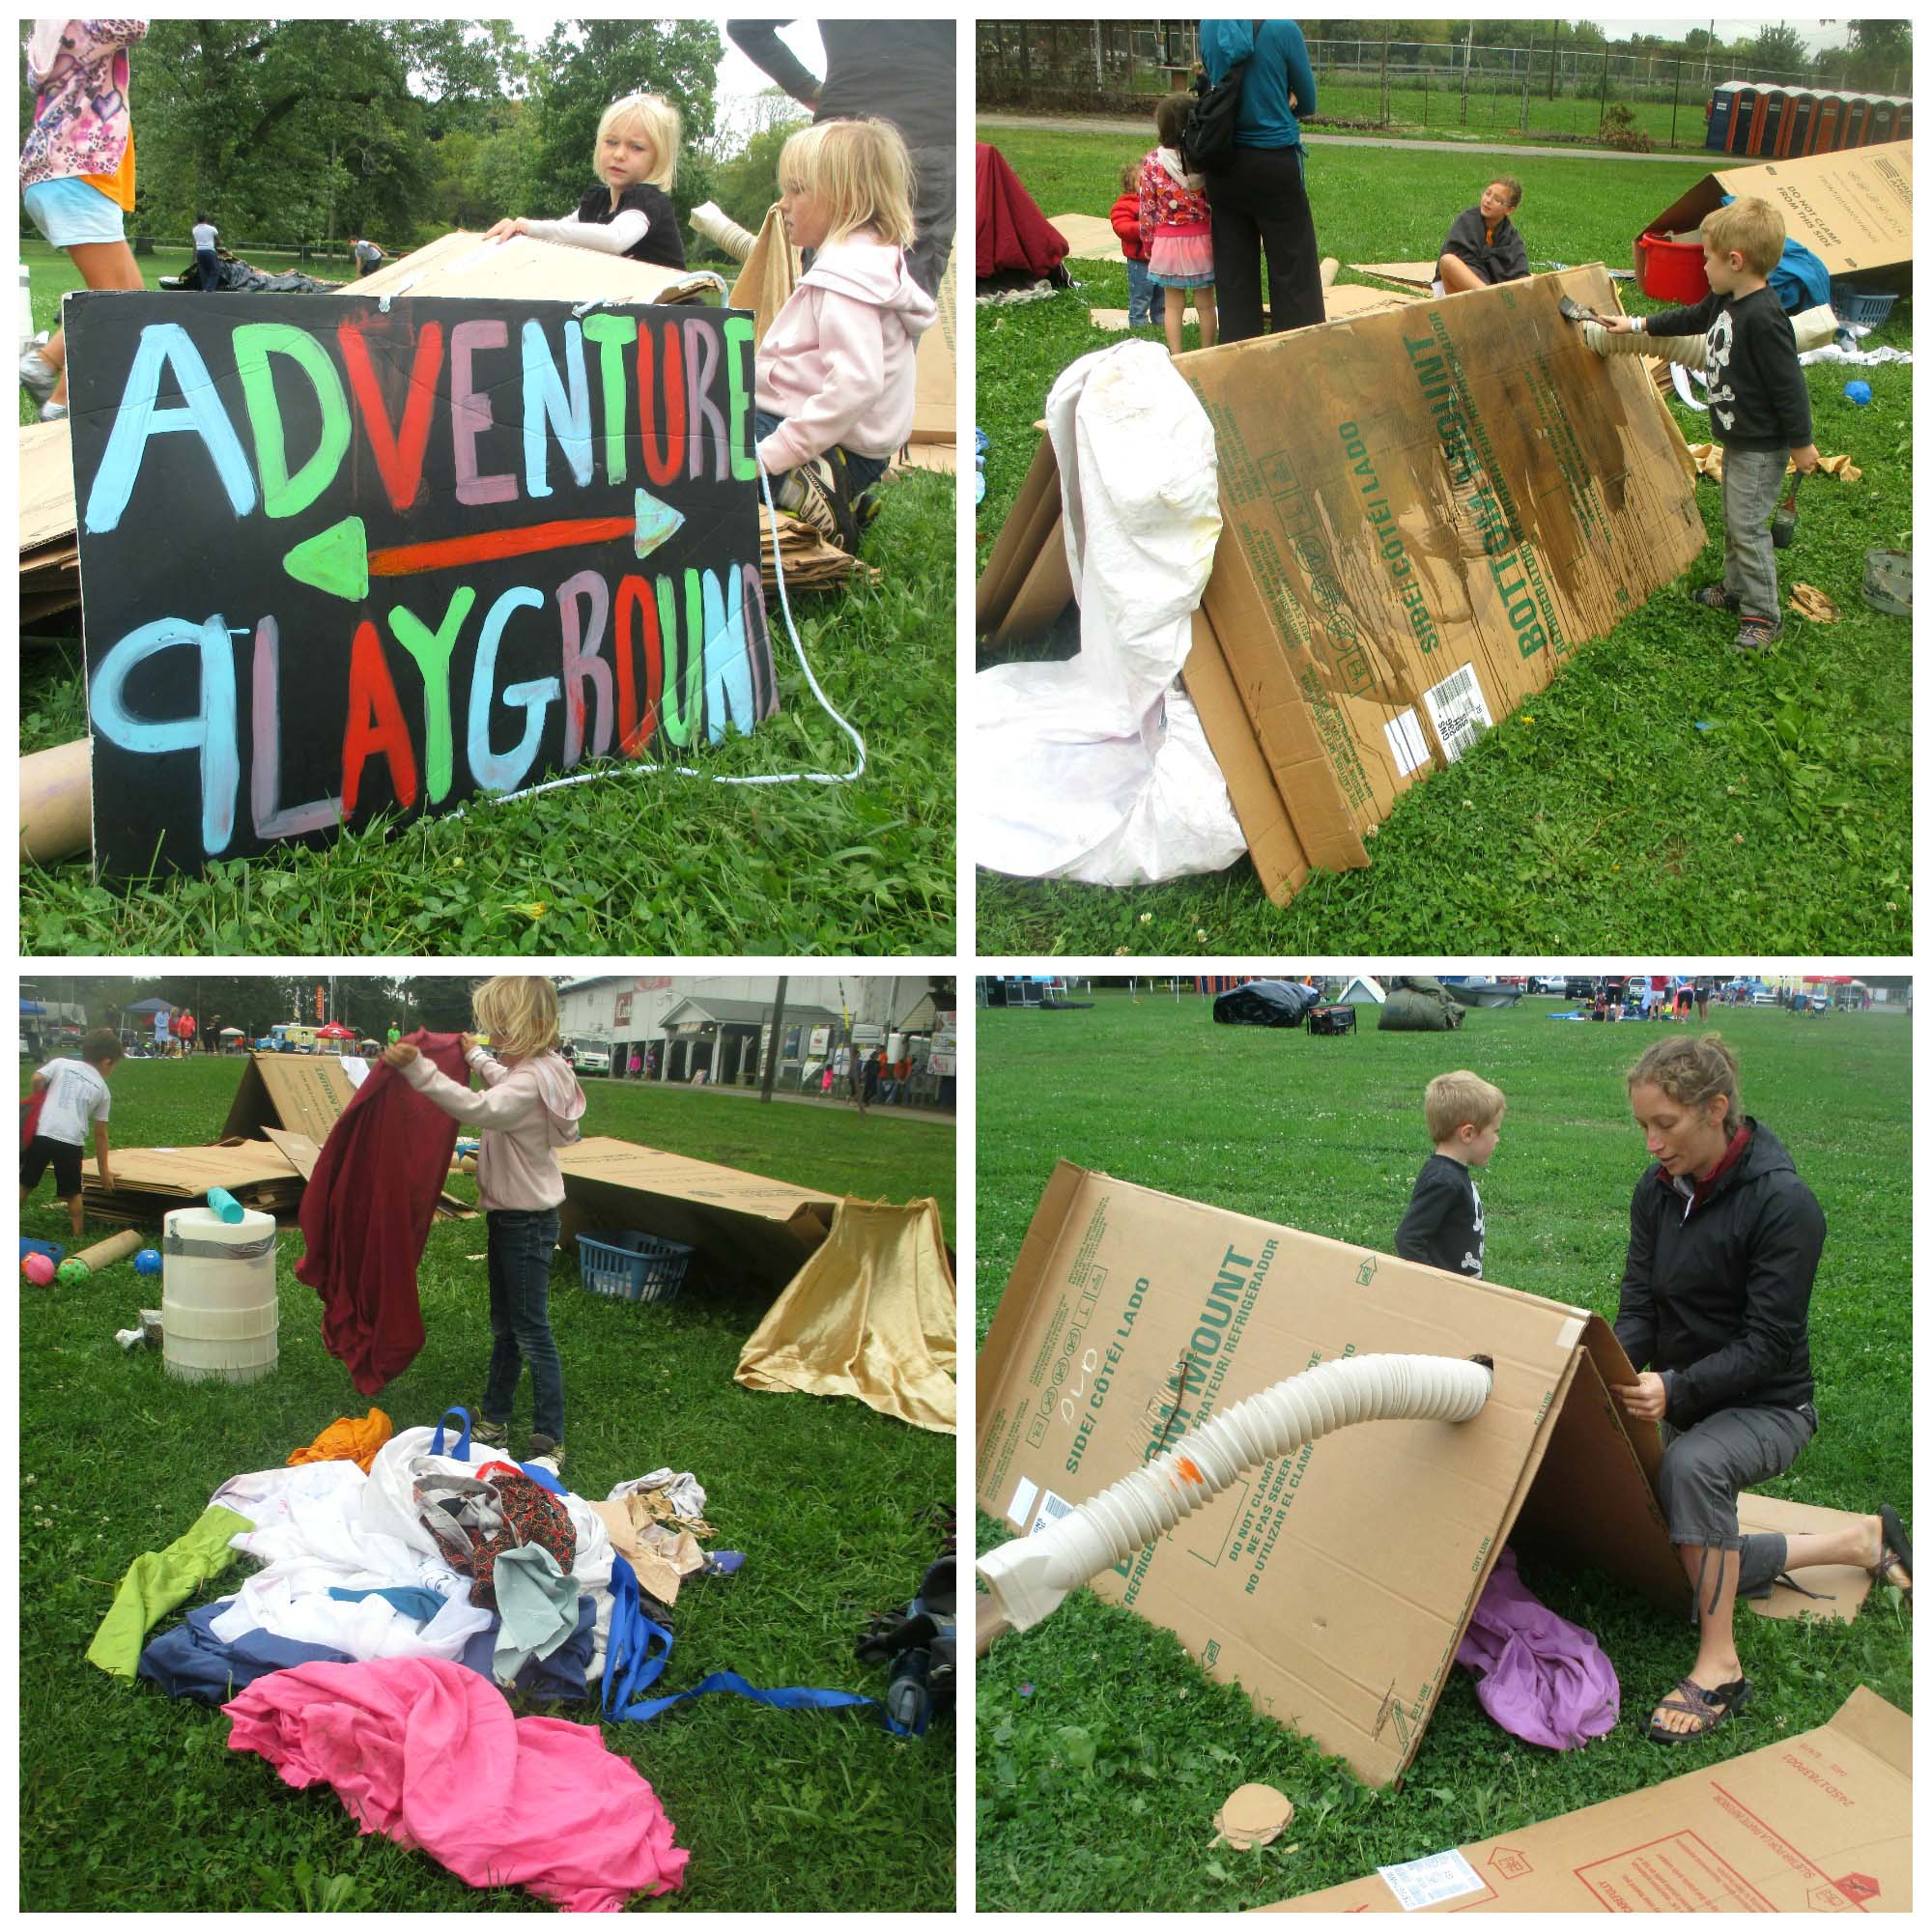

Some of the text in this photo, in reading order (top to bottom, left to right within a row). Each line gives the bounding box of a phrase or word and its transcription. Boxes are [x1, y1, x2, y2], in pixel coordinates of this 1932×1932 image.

[1776, 185, 1833, 250] FROM THIS SIDE
[1786, 184, 1841, 247] DO NOT CLAMP
[85, 312, 759, 534] ADVENTURE
[1401, 323, 1551, 660] BOTTOM MOUNT
[1336, 417, 1442, 655] SIDE/ CÔTÉ/ LADO
[1436, 719, 1451, 741] GNS
[1444, 716, 1458, 736] 23G
[1458, 711, 1469, 726] SS
[314, 1064, 336, 1106] MOUNT
[1167, 1242, 1261, 1396] MOUNT
[1219, 1236, 1284, 1353] REFRIGERADOR
[1060, 1275, 1151, 1475] SIDE/ CÔTÉ/ LADO
[1247, 1459, 1278, 1509] CLAMP
[1285, 1438, 1317, 1490] CLAMP
[1234, 1507, 1258, 1542] NOT
[1243, 1457, 1293, 1555] NE PAS SERER
[1278, 1488, 1295, 1507] EL
[1227, 1541, 1243, 1561] DO
[1251, 1507, 1289, 1572] UTILIZAR
[1243, 1571, 1262, 1594] NO
